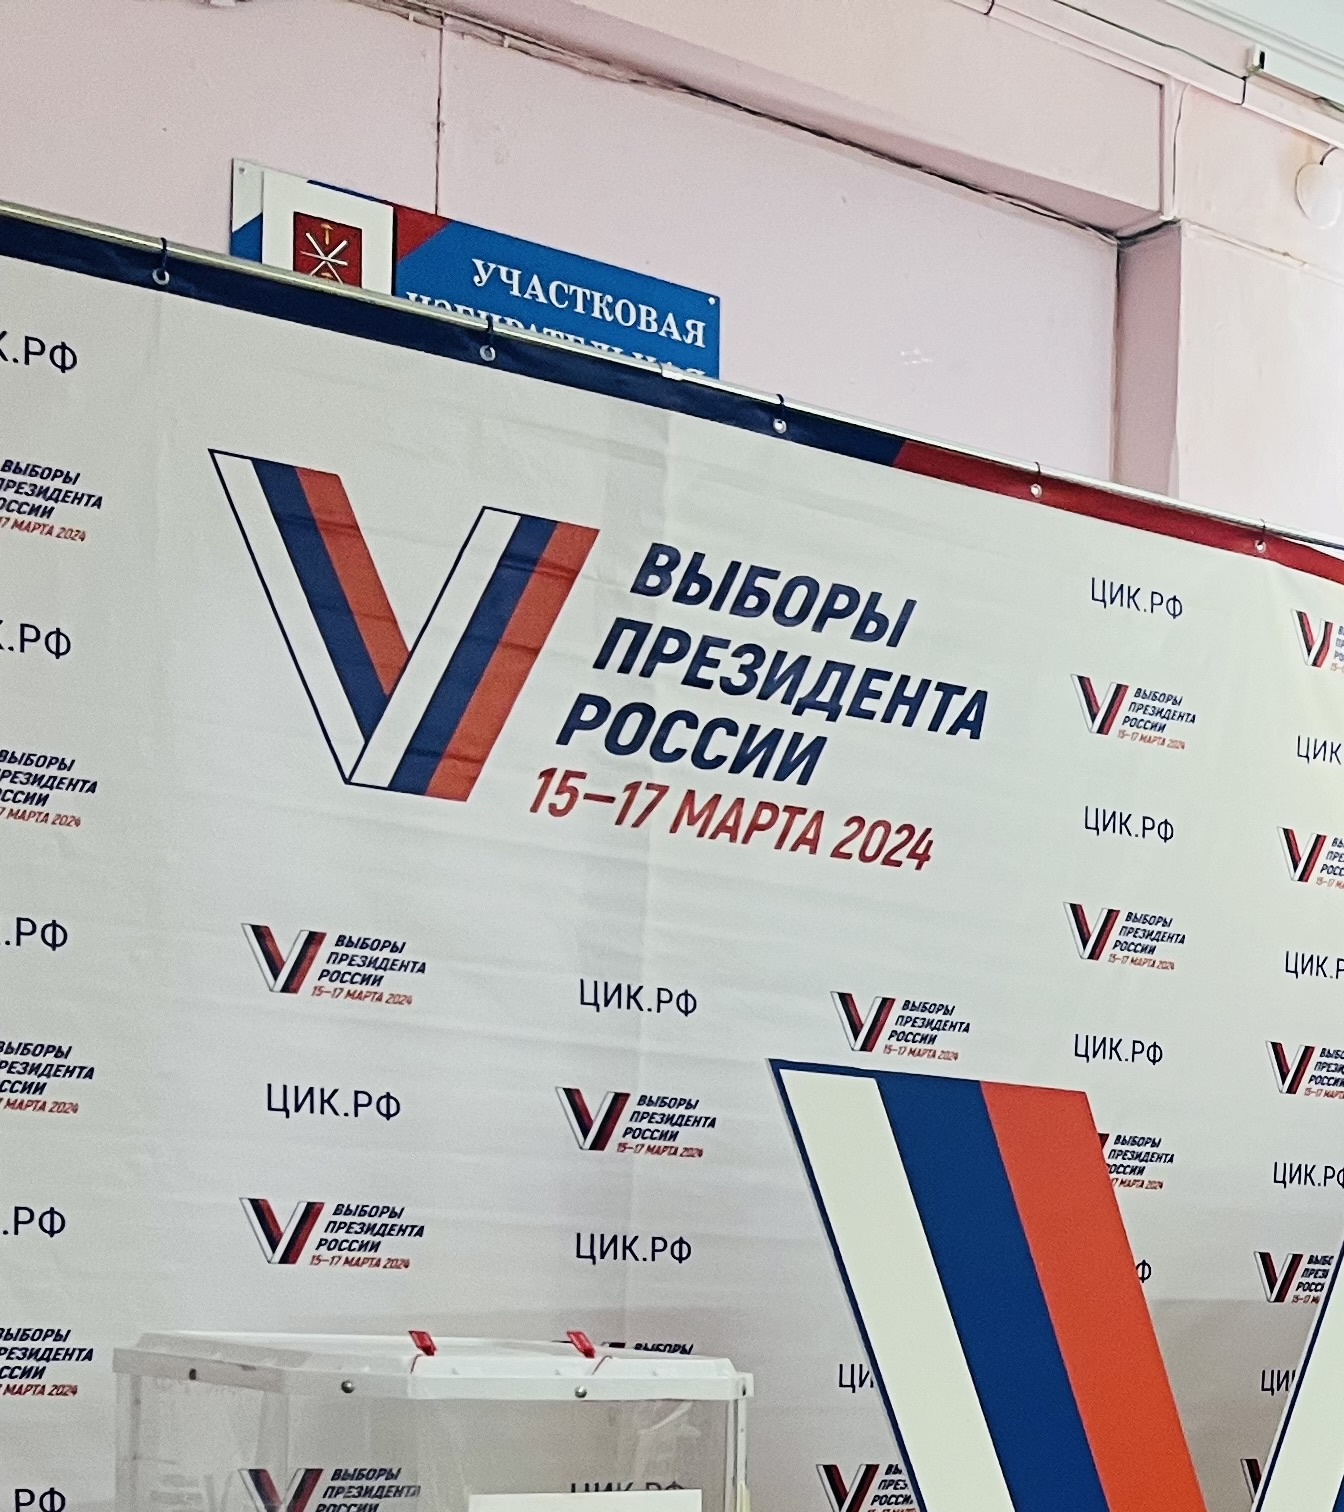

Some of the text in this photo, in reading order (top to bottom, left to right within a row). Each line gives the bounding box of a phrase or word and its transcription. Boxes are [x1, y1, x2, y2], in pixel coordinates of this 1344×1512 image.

[471, 258, 706, 349] УЧАСТКОВАЯ
[0, 330, 77, 373] .РФ
[1, 459, 80, 485] ВЫБОРЫ
[0, 500, 55, 519] ССИИ
[11, 517, 52, 536] МАРТА
[629, 541, 918, 648] ВЫБОРЫ
[1091, 577, 1183, 619] ЦИК.РФ
[0, 619, 71, 659] .РФ
[592, 616, 989, 740] ПРЕЗИДЕНТА
[1134, 687, 1183, 706] ВЫБОРЫ
[1128, 701, 1196, 724] ПРЕЗИДЕНТА
[1122, 715, 1167, 733] РОССИИ
[555, 692, 828, 786] РОССИИ
[0, 768, 97, 793] РЕЗИДЕНТА
[0, 788, 49, 807] ССИИ
[7, 808, 49, 824] МАРТА
[1084, 806, 1174, 843] ЦИК.РФ
[669, 788, 825, 855] МАРТА
[829, 815, 935, 872] 2024
[1125, 911, 1173, 928] ВЫБОРЫ
[5, 917, 68, 951] .РФ
[1118, 925, 1186, 945] ПРЕЗИДЕНТА
[334, 935, 406, 954] ВЫБОРЫ
[1112, 940, 1157, 955] РОССИИ
[326, 952, 426, 974] ПРЕЗИДЕНТА
[318, 969, 384, 987] РОССИИ
[345, 989, 383, 1003] МАРТА
[385, 993, 413, 1005] 2024
[580, 979, 697, 1016] ЦИК.РФ
[901, 999, 956, 1016] ВЫБОРЫ
[895, 1015, 970, 1034] ПРЕЗИДЕНТА
[887, 1030, 937, 1046] РОССИИ
[1074, 1034, 1163, 1065] ЦИК.РФ
[0, 1060, 94, 1080] РЕЗИДЕНТА
[0, 1079, 47, 1096] ССИИ
[4, 1099, 46, 1112] МАРТА
[267, 1083, 401, 1120] ЦИК.РФ
[637, 1095, 699, 1110] ВЫБОРЫ
[629, 1111, 716, 1129] ПРЕЗИДЕНТА
[622, 1127, 679, 1142] РОССИИ
[1114, 1134, 1161, 1148] ВЫБОРЫ
[1108, 1149, 1174, 1164] ПРЕЗИДЕНТА
[332, 1203, 404, 1219] ВЫБОРЫ
[2, 1206, 66, 1238] .РФ
[324, 1220, 425, 1238] ПРЕЗИДЕНТА
[315, 1238, 381, 1253] РОССИИ
[575, 1232, 692, 1265] ЦИК.РФ
[342, 1256, 381, 1268] МАРТА
[383, 1258, 410, 1270] 2024
[0, 1347, 93, 1364] РЕЗИДЕНТА
[0, 1365, 46, 1380] ССИИ
[3, 1384, 45, 1397] МАРТА
[331, 1467, 401, 1482] ВЫБОРЫ
[323, 1484, 421, 1500] ПРЕЗИДЕНТА
[871, 1494, 913, 1506] РОССИ
